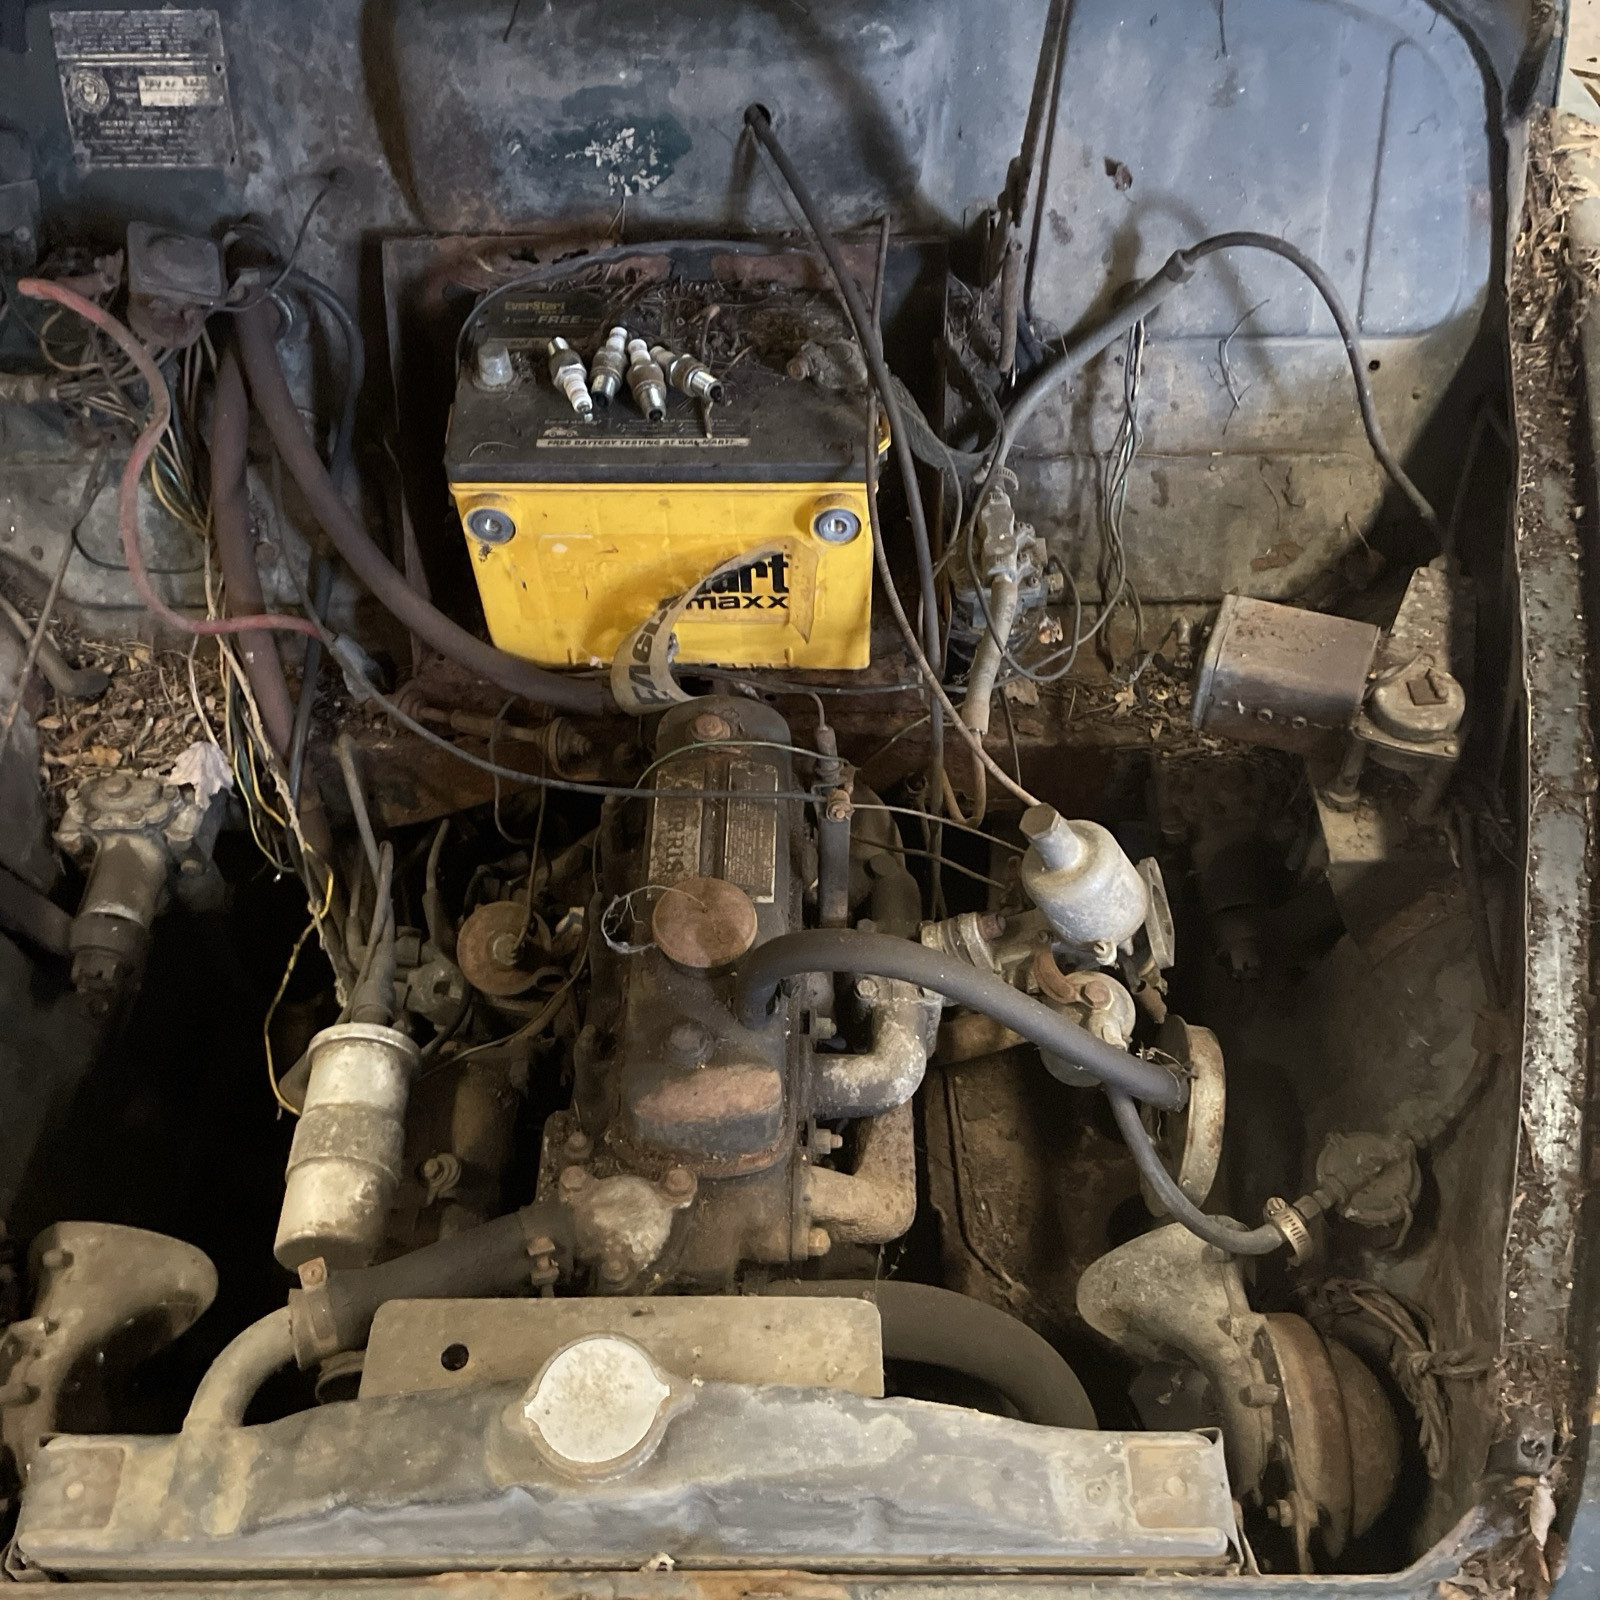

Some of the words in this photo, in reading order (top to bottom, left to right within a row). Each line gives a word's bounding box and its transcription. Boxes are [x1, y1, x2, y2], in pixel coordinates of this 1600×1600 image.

[504, 301, 566, 310] EverStart
[537, 314, 582, 324] FREE
[686, 595, 789, 610] maxx
